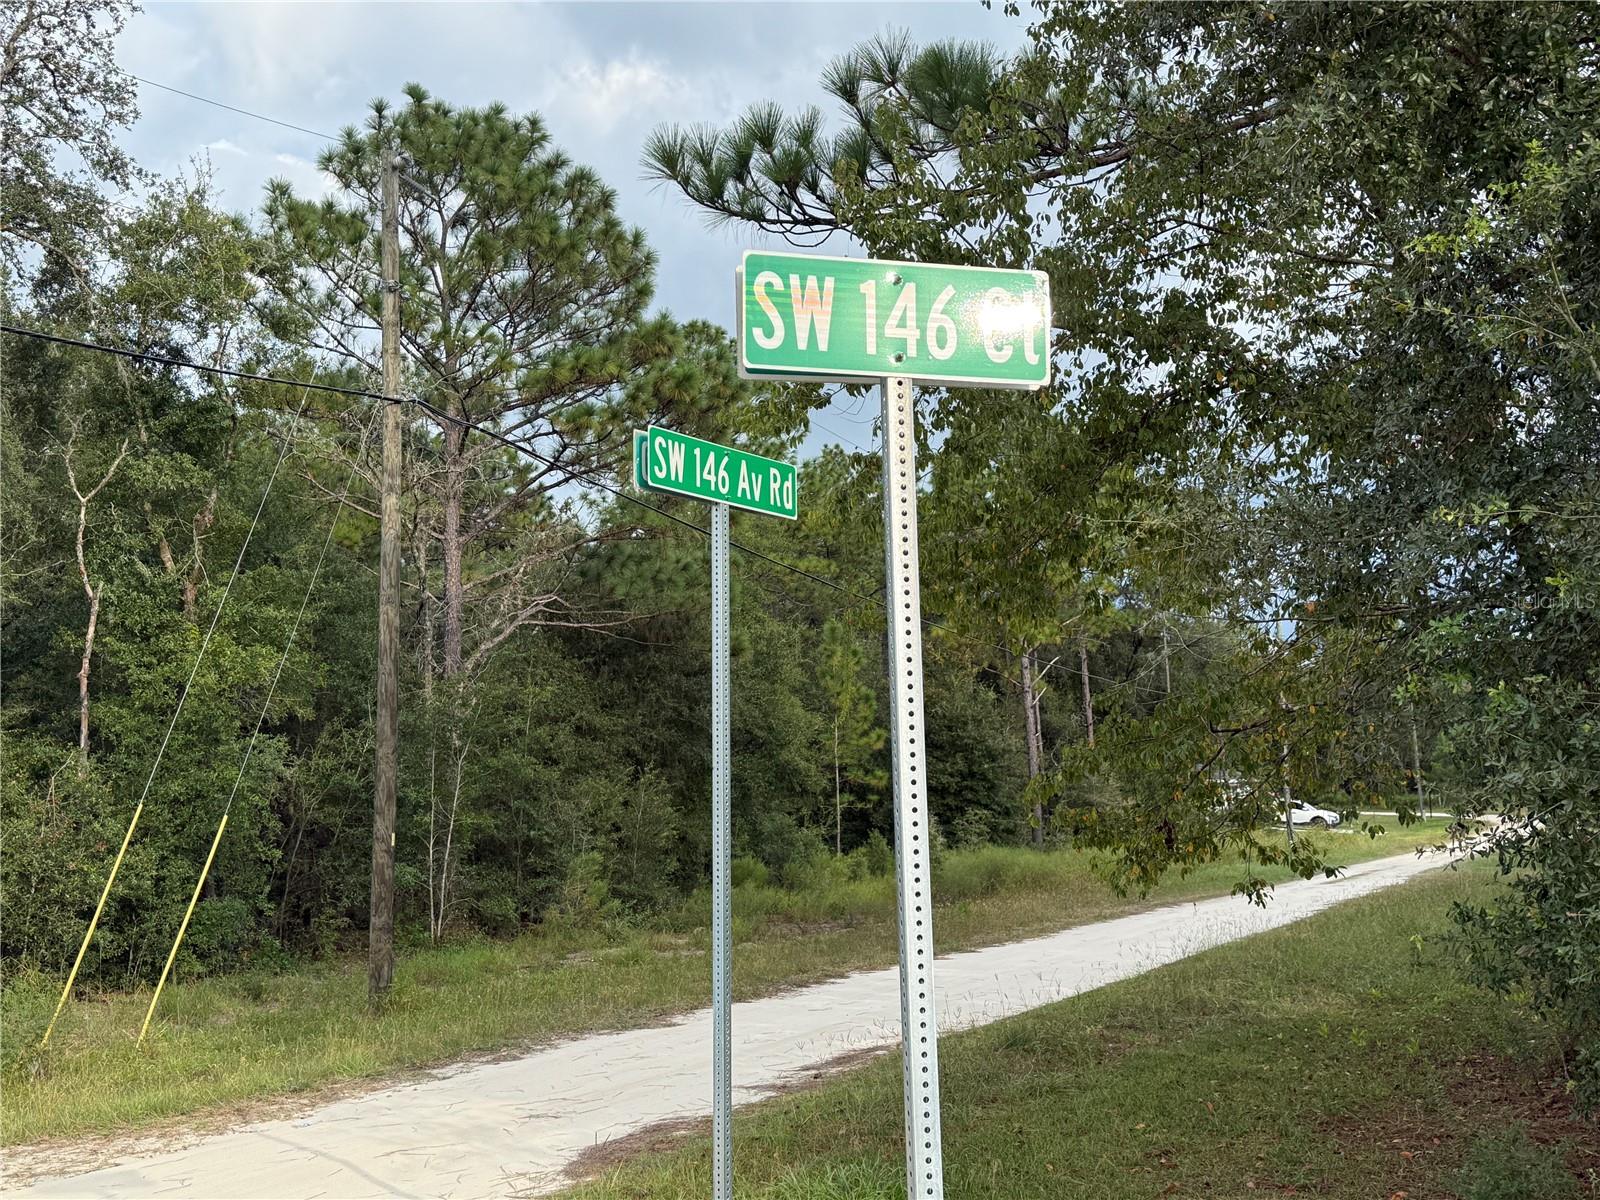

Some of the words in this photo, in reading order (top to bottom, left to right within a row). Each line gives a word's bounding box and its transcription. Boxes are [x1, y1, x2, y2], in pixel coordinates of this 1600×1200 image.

[752, 270, 834, 352] SW
[859, 279, 957, 361] 146
[982, 286, 1040, 364] Ct
[653, 435, 685, 483] SW
[693, 446, 730, 495] 146
[738, 460, 762, 502] Av
[769, 467, 793, 510] Rd
